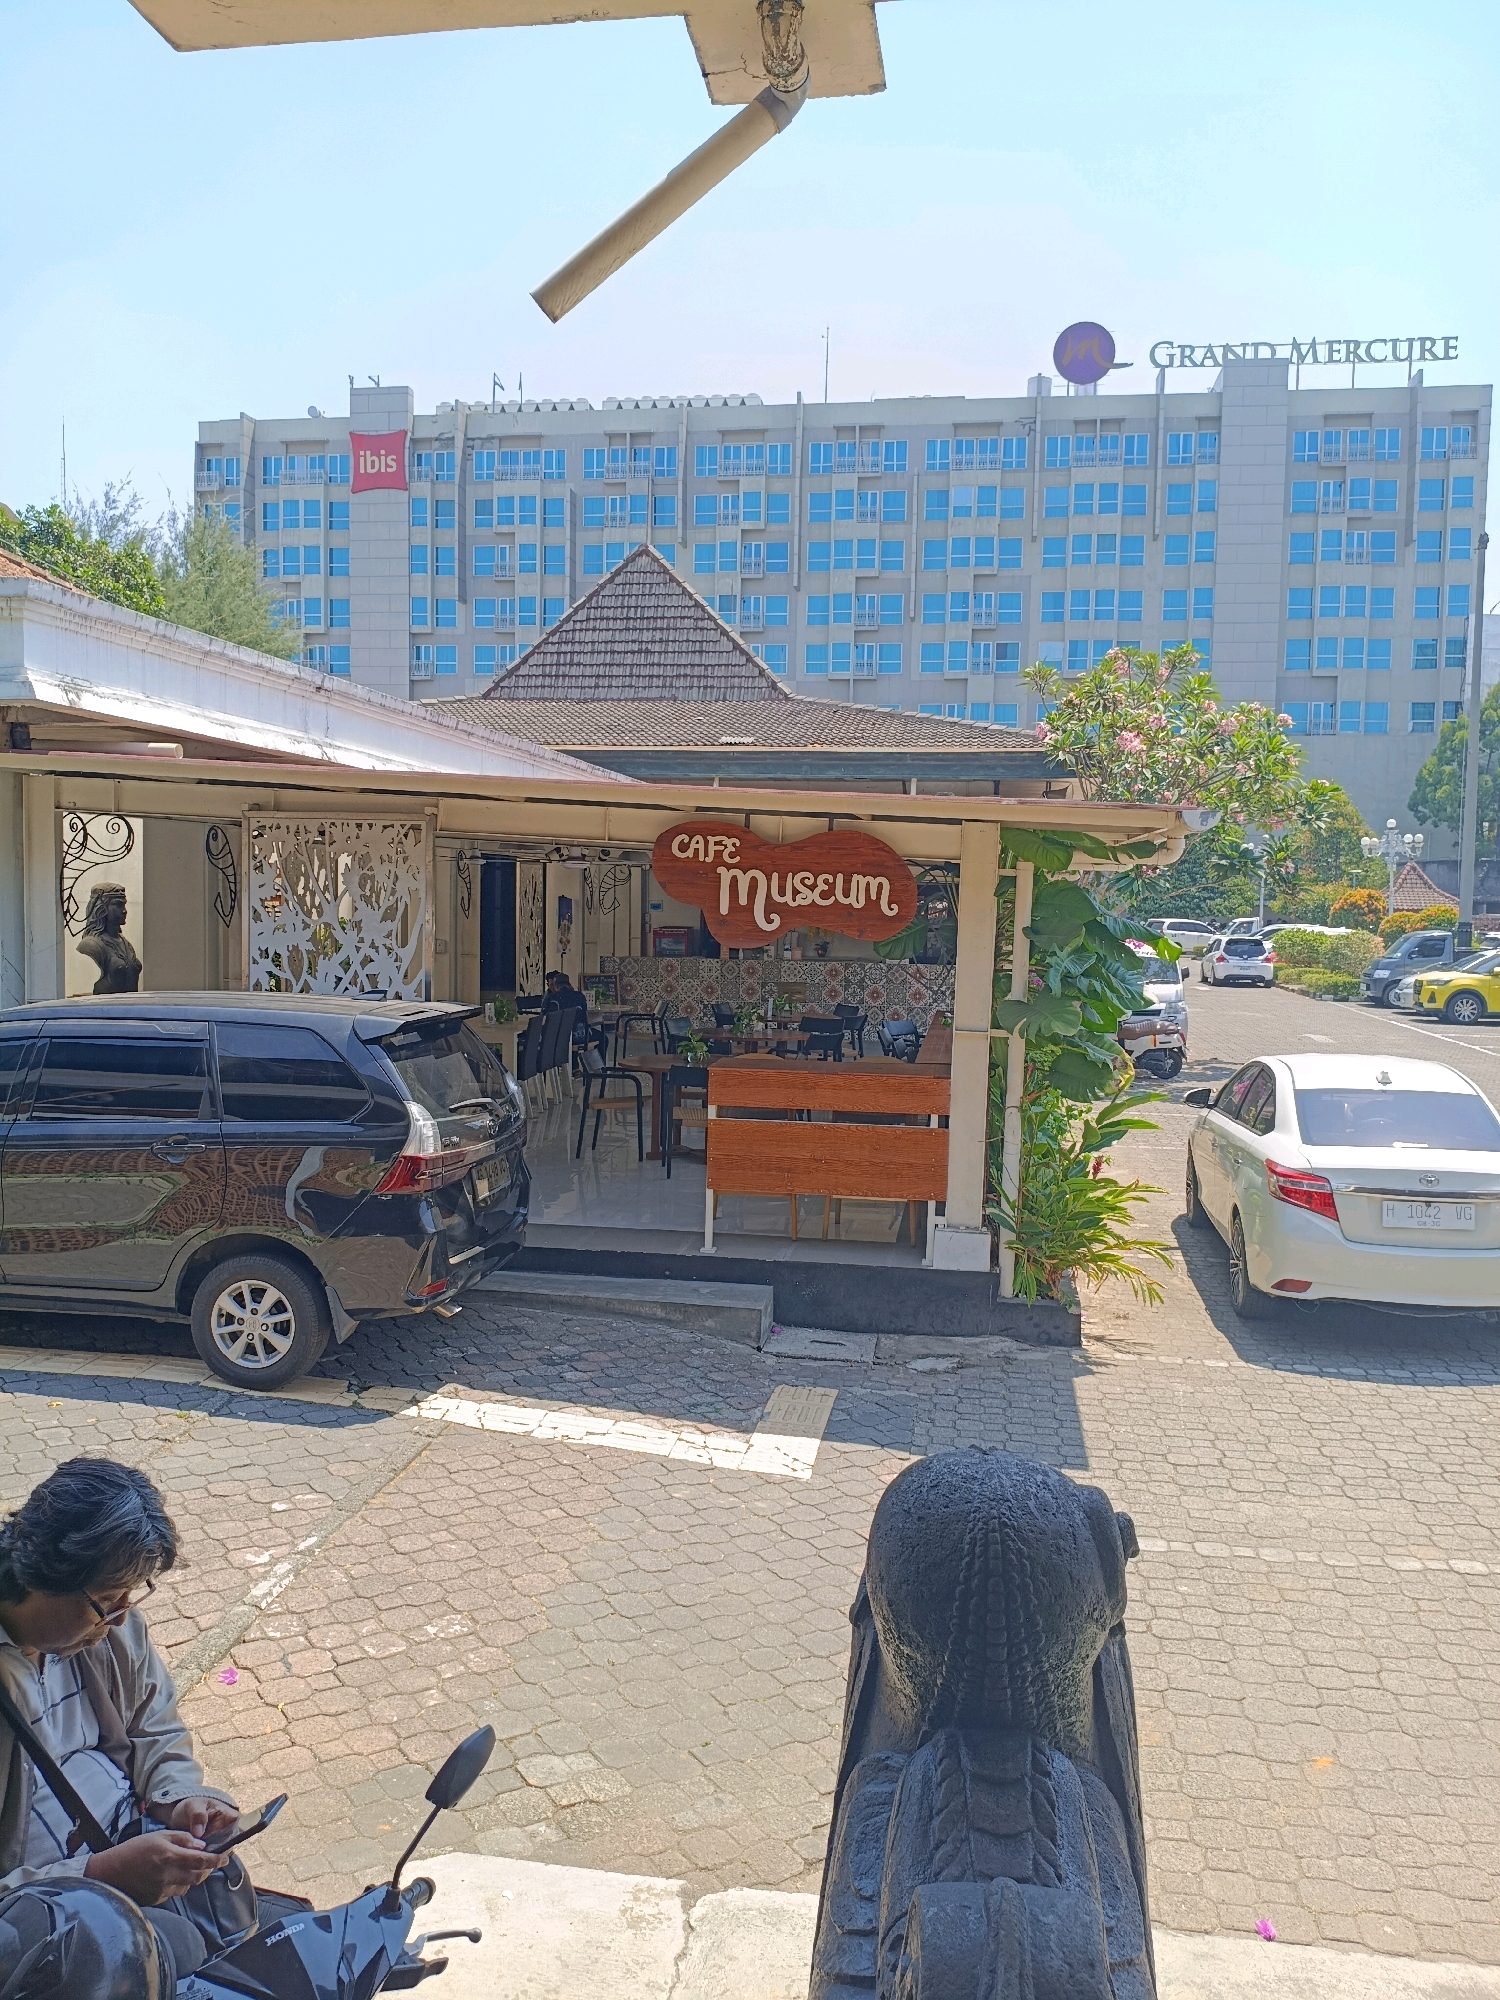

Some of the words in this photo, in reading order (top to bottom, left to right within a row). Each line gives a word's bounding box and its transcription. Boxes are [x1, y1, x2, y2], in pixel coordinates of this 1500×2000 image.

[1149, 340, 1277, 368] GRAND
[1289, 336, 1459, 364] MERCURE
[359, 449, 398, 474] ibis
[671, 833, 741, 864] CAFE
[1386, 1203, 1395, 1218] H
[1407, 1204, 1441, 1220] 1042
[1455, 1205, 1472, 1221] VG
[264, 1922, 305, 1947] HONDA
